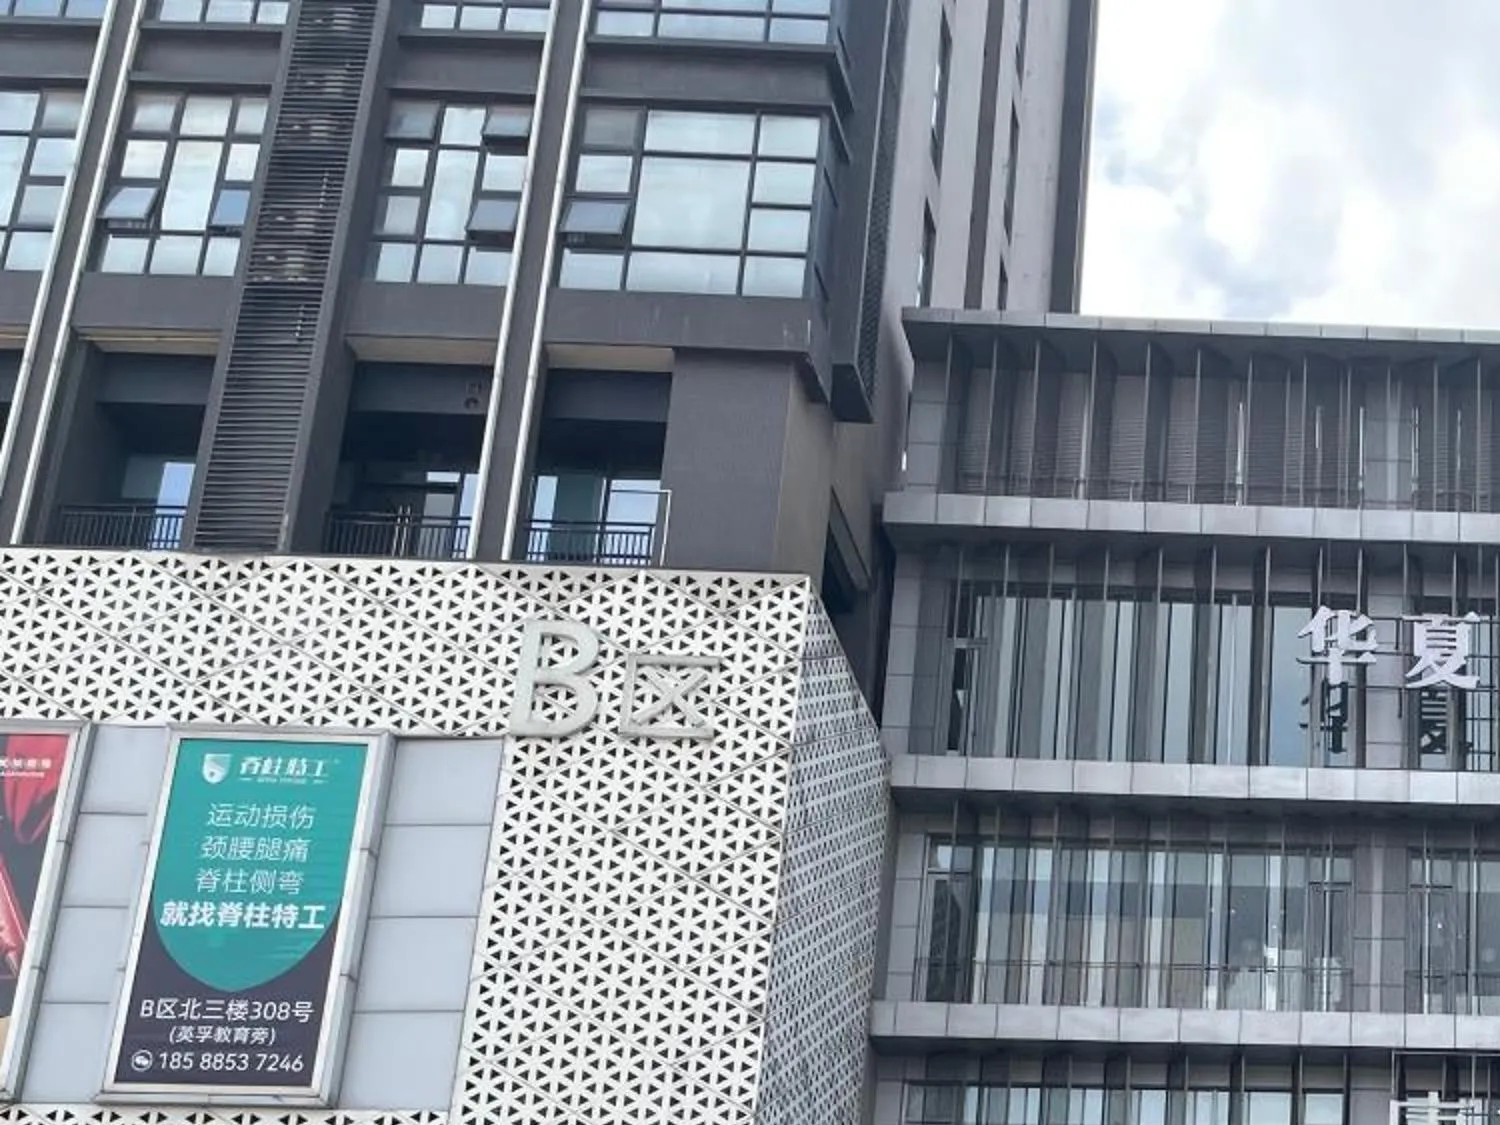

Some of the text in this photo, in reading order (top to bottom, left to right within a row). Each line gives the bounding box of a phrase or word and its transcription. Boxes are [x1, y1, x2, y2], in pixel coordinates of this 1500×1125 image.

[509, 618, 722, 740] B区
[206, 803, 317, 830] 运动损伤
[201, 835, 311, 863] 颈腰腿痛
[196, 867, 305, 895] 脊柱侧弯
[160, 900, 327, 929] 就找脊柱特工
[139, 998, 315, 1023] B区北三楼308号
[158, 1052, 305, 1073] 185 8853 7246
